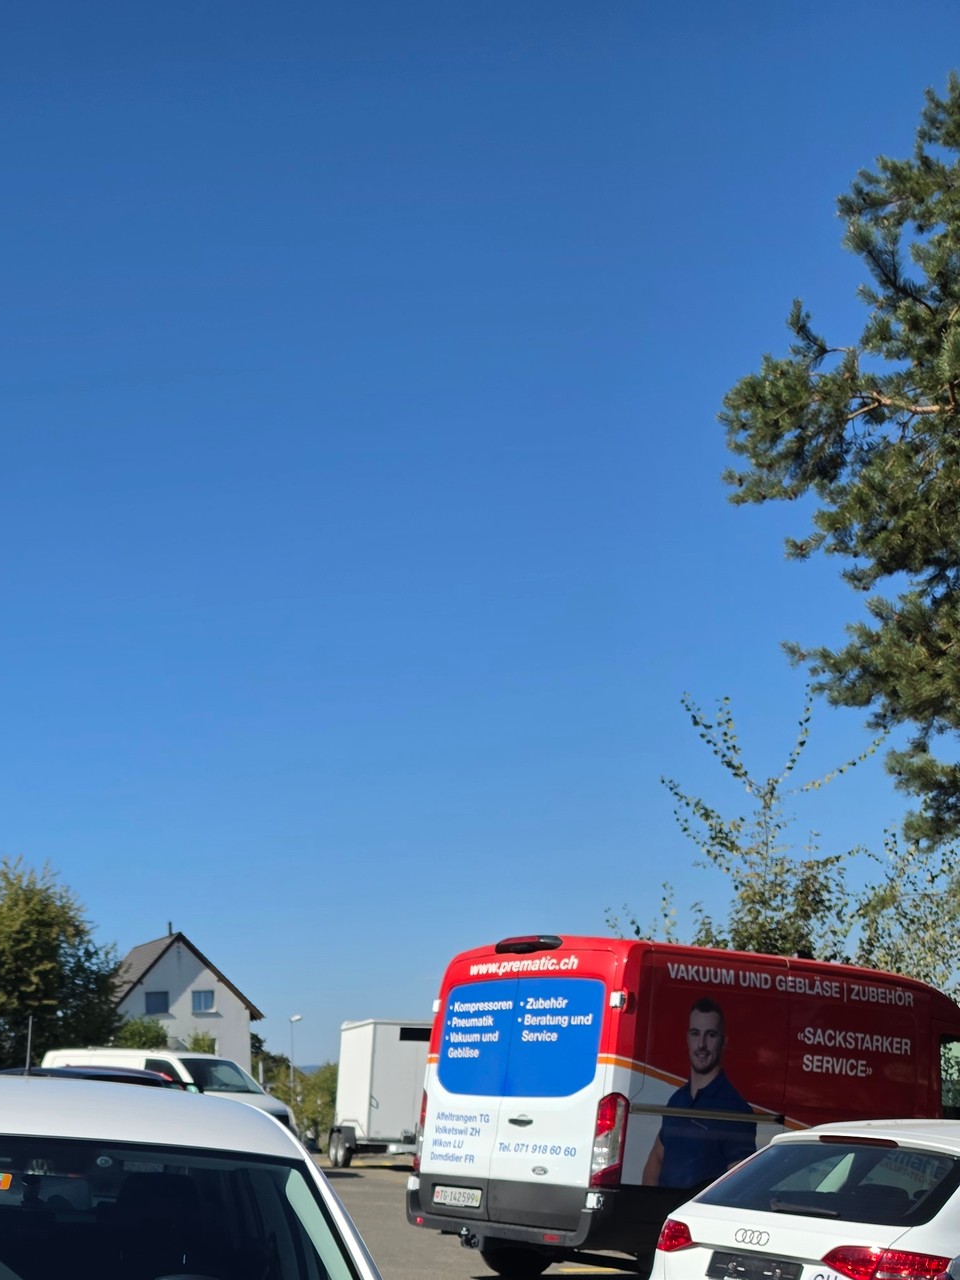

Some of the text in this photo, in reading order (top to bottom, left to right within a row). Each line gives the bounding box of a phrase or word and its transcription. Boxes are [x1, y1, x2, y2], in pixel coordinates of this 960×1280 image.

[469, 955, 579, 976] www.prematic.ch
[667, 962, 914, 1008] VAKUUM UND GEBLÄSE ZUBEHÖR
[453, 1000, 513, 1013] Kompressoren
[525, 996, 568, 1010] Zubehör
[451, 1015, 494, 1028] Pneumatik
[523, 1013, 593, 1028] Beratung und
[449, 1030, 499, 1043] Vakuum und
[521, 1029, 558, 1042] Service
[447, 1046, 479, 1058] Gebläse
[479, 1113, 490, 1124] TG
[469, 1126, 481, 1137] ZH
[452, 1139, 464, 1149] LU
[498, 1142, 577, 1158] Tel. 071 918 60 60
[464, 1153, 475, 1164] FR
